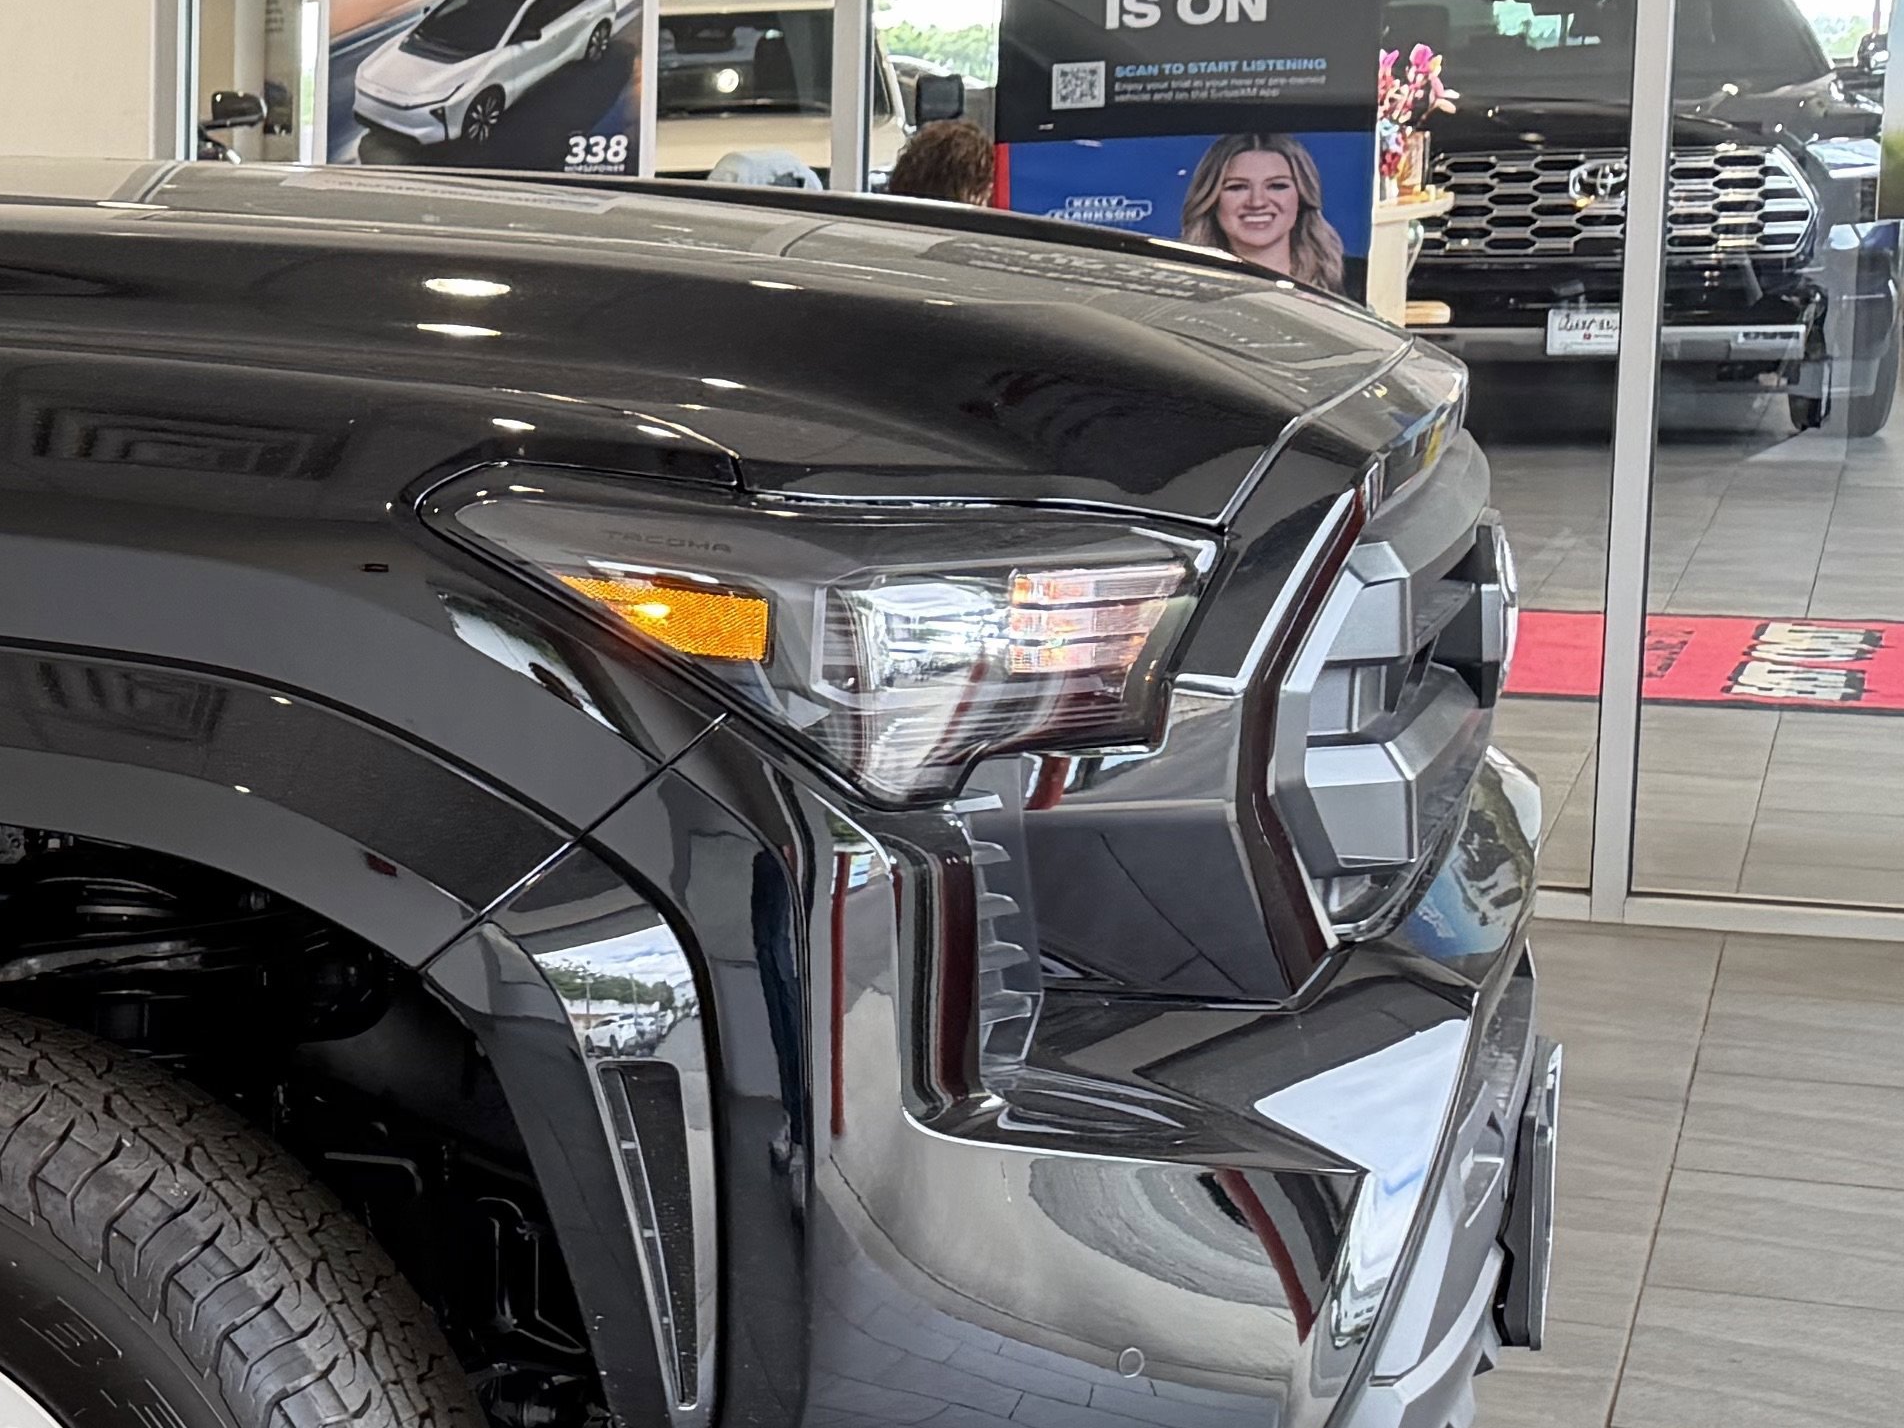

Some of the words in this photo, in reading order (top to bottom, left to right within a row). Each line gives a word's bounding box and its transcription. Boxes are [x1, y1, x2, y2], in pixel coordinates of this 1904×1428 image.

[1114, 64, 1159, 77] SCAN
[1162, 62, 1185, 75] TO
[1187, 61, 1239, 74] START
[1242, 58, 1327, 72] LISTENING
[565, 135, 628, 164] 338
[602, 529, 732, 554] TACOMA
